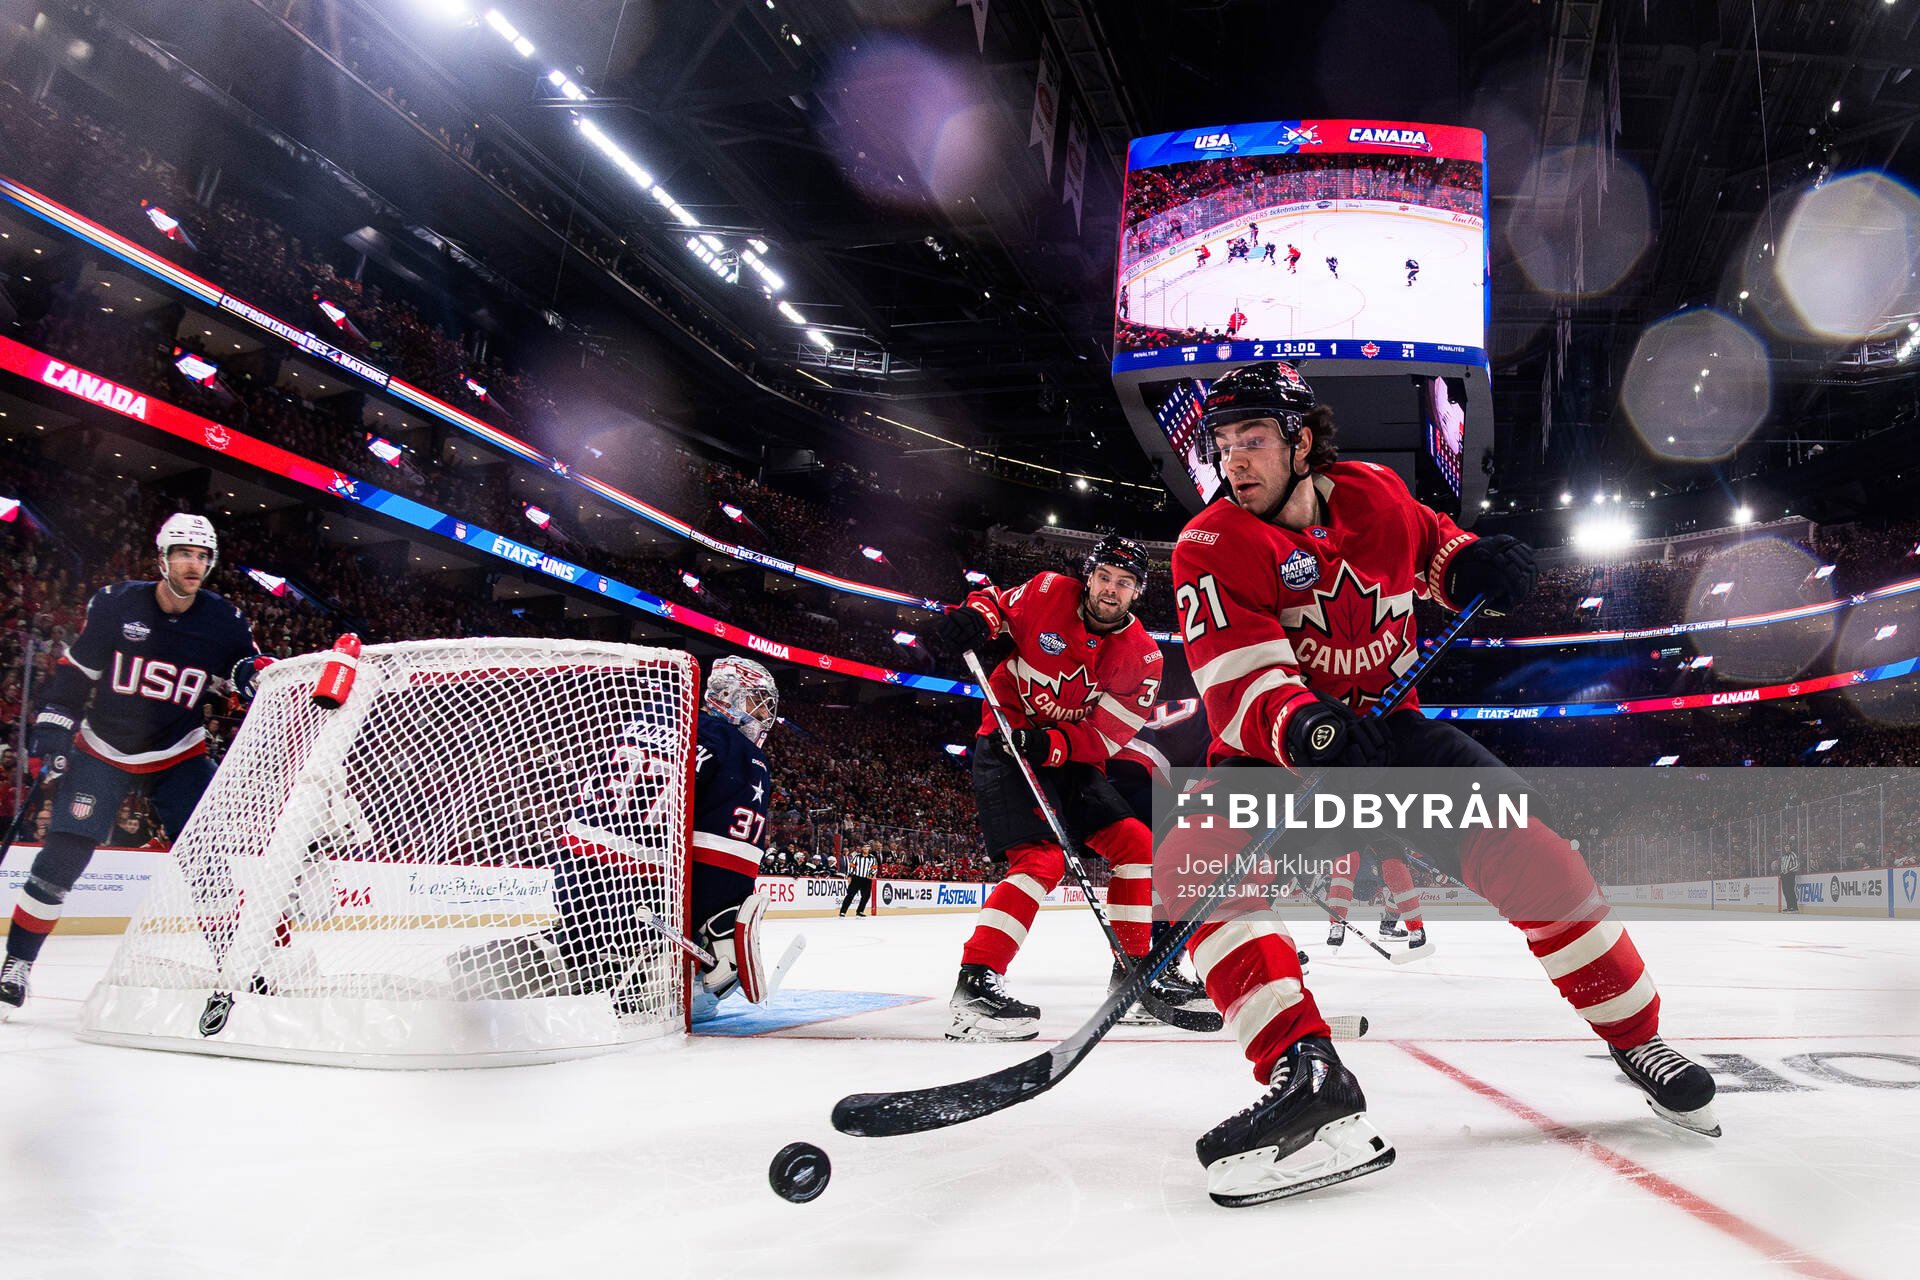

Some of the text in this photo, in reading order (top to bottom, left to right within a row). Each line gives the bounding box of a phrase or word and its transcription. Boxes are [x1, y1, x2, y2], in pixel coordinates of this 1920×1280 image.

[1194, 133, 1231, 149] USA
[1348, 128, 1426, 144] CANADA
[1452, 213, 1466, 223] Tim
[221, 294, 308, 343] CONFRONTATION
[308, 336, 329, 356] DES
[340, 352, 389, 386] NATIONS
[1276, 342, 1316, 353] 13:00
[1183, 353, 1196, 362] 19
[1253, 344, 1264, 357] 2
[1330, 342, 1337, 356] 1
[1401, 349, 1415, 358] 21
[43, 360, 147, 420] CANADA
[492, 536, 575, 580] ÉTATS-UNIS
[762, 556, 796, 573] NATIONS
[1281, 556, 1318, 576] NATIONS
[1285, 565, 1317, 582] FACE-OFF
[1177, 573, 1229, 644] 21
[1624, 628, 1675, 639] CONFRONTATION
[1695, 620, 1726, 631] NATIONS
[748, 635, 789, 660] CANADA
[1040, 632, 1068, 650] NATIONS
[1296, 629, 1398, 675] CANADA
[112, 650, 207, 709] USA
[1138, 678, 1160, 708] 3
[1712, 690, 1760, 704] CANADA
[1477, 707, 1539, 719] ÉTATS-UNIS
[98, 884, 124, 892] CARDS
[754, 883, 795, 902] GERS
[807, 880, 849, 896] BODYAR
[894, 888, 932, 900] NHL 25
[937, 885, 977, 905] FASTENAL
[1063, 887, 1086, 903] TYLENO
[1796, 882, 1824, 902] STENAL
[1841, 880, 1882, 896] NHL 25
